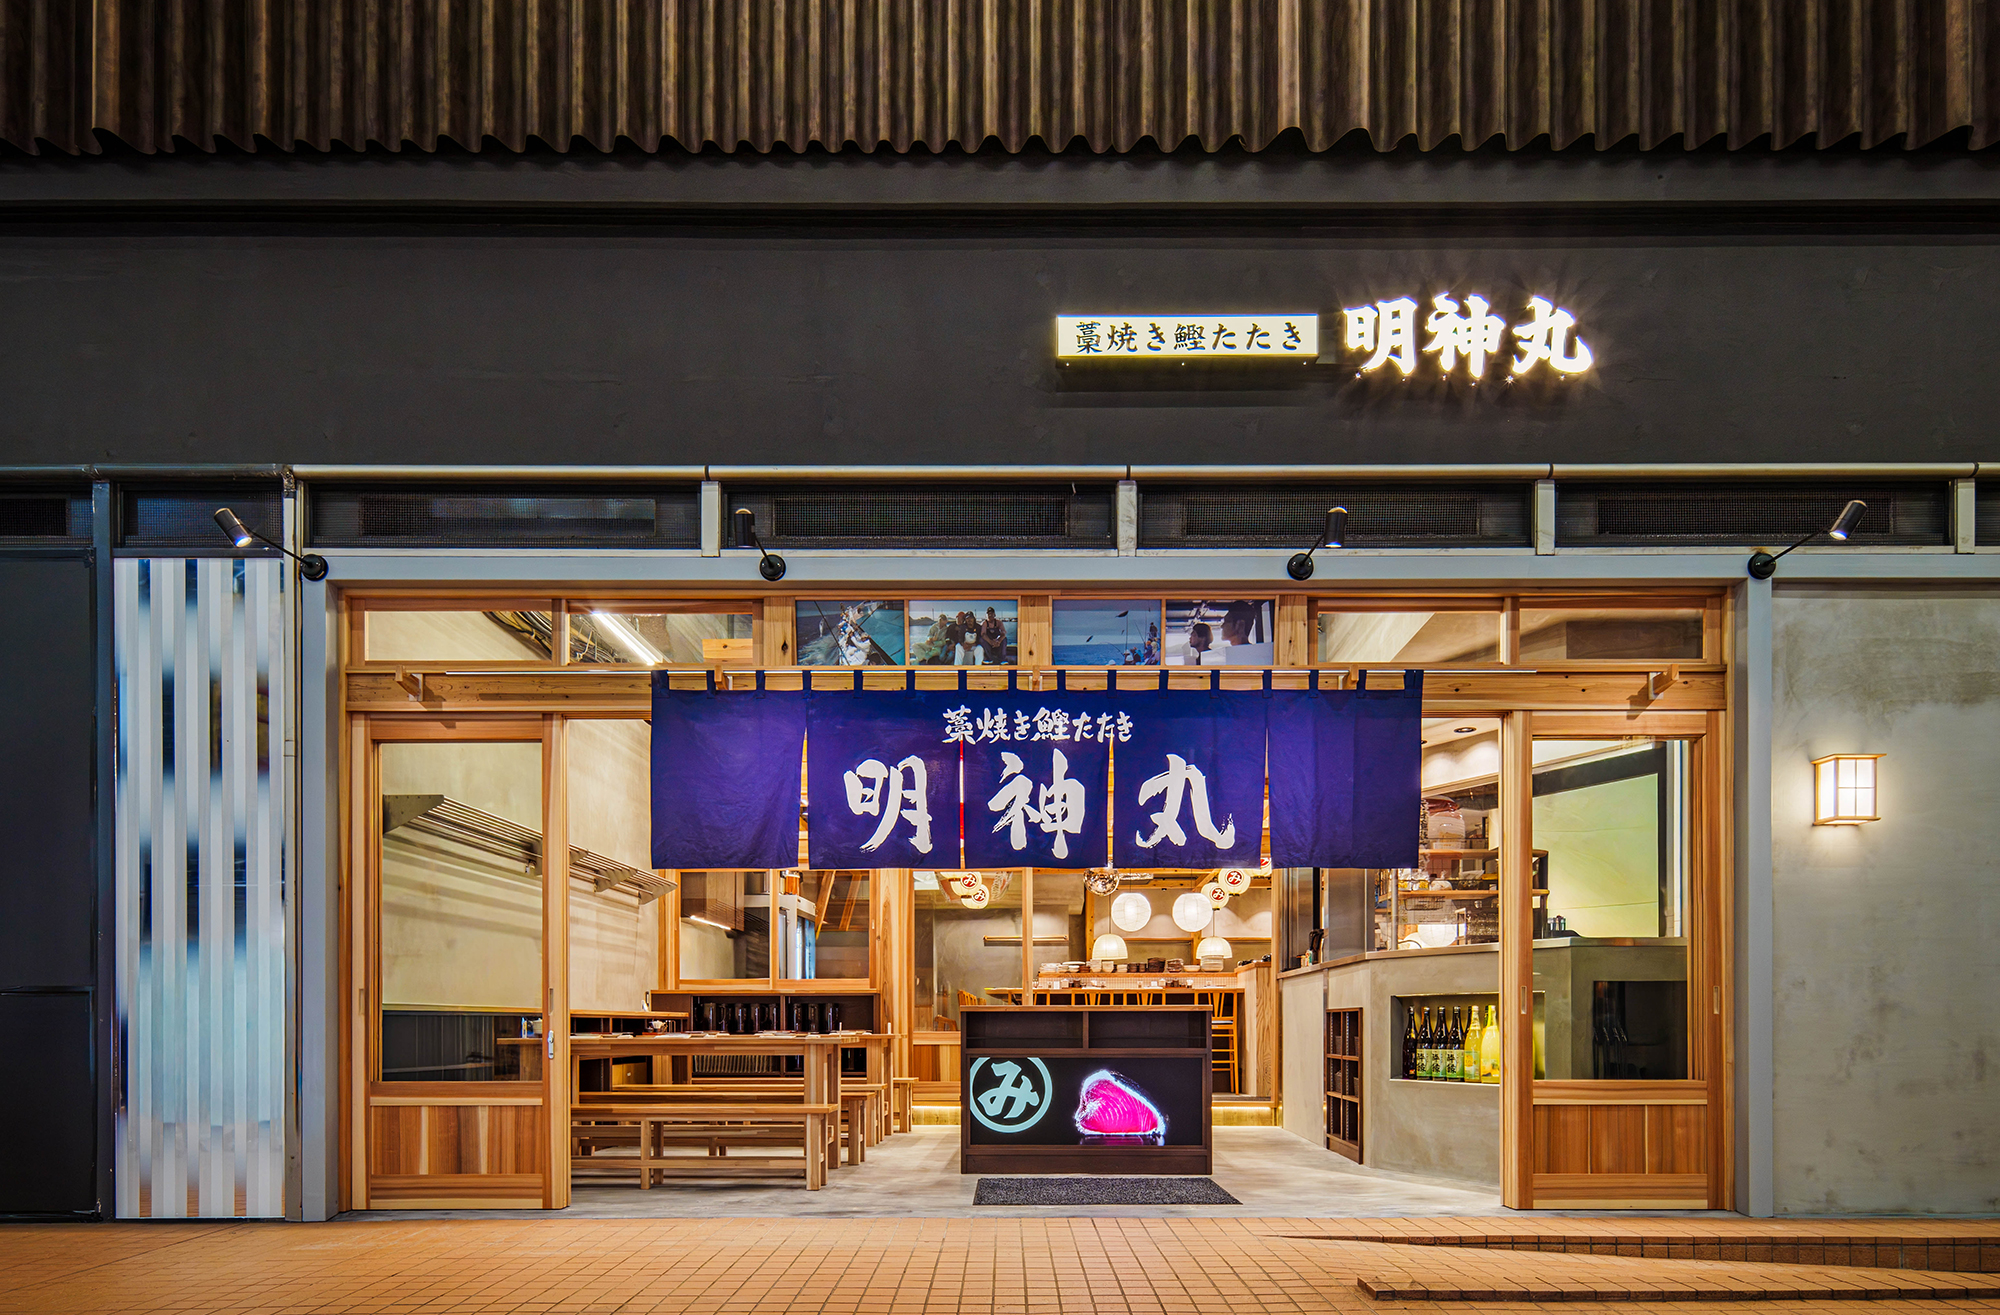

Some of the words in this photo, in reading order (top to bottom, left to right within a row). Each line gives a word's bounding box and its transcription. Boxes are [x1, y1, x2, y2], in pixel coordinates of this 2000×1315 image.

[1076, 321, 1302, 354] 藁焼き鰹たたき
[1343, 293, 1594, 377] 明神丸
[942, 704, 1134, 745] 藁焼き鰹たたき
[844, 748, 1236, 859] 明神丸
[1228, 871, 1242, 884] み
[977, 1060, 1040, 1118] み
